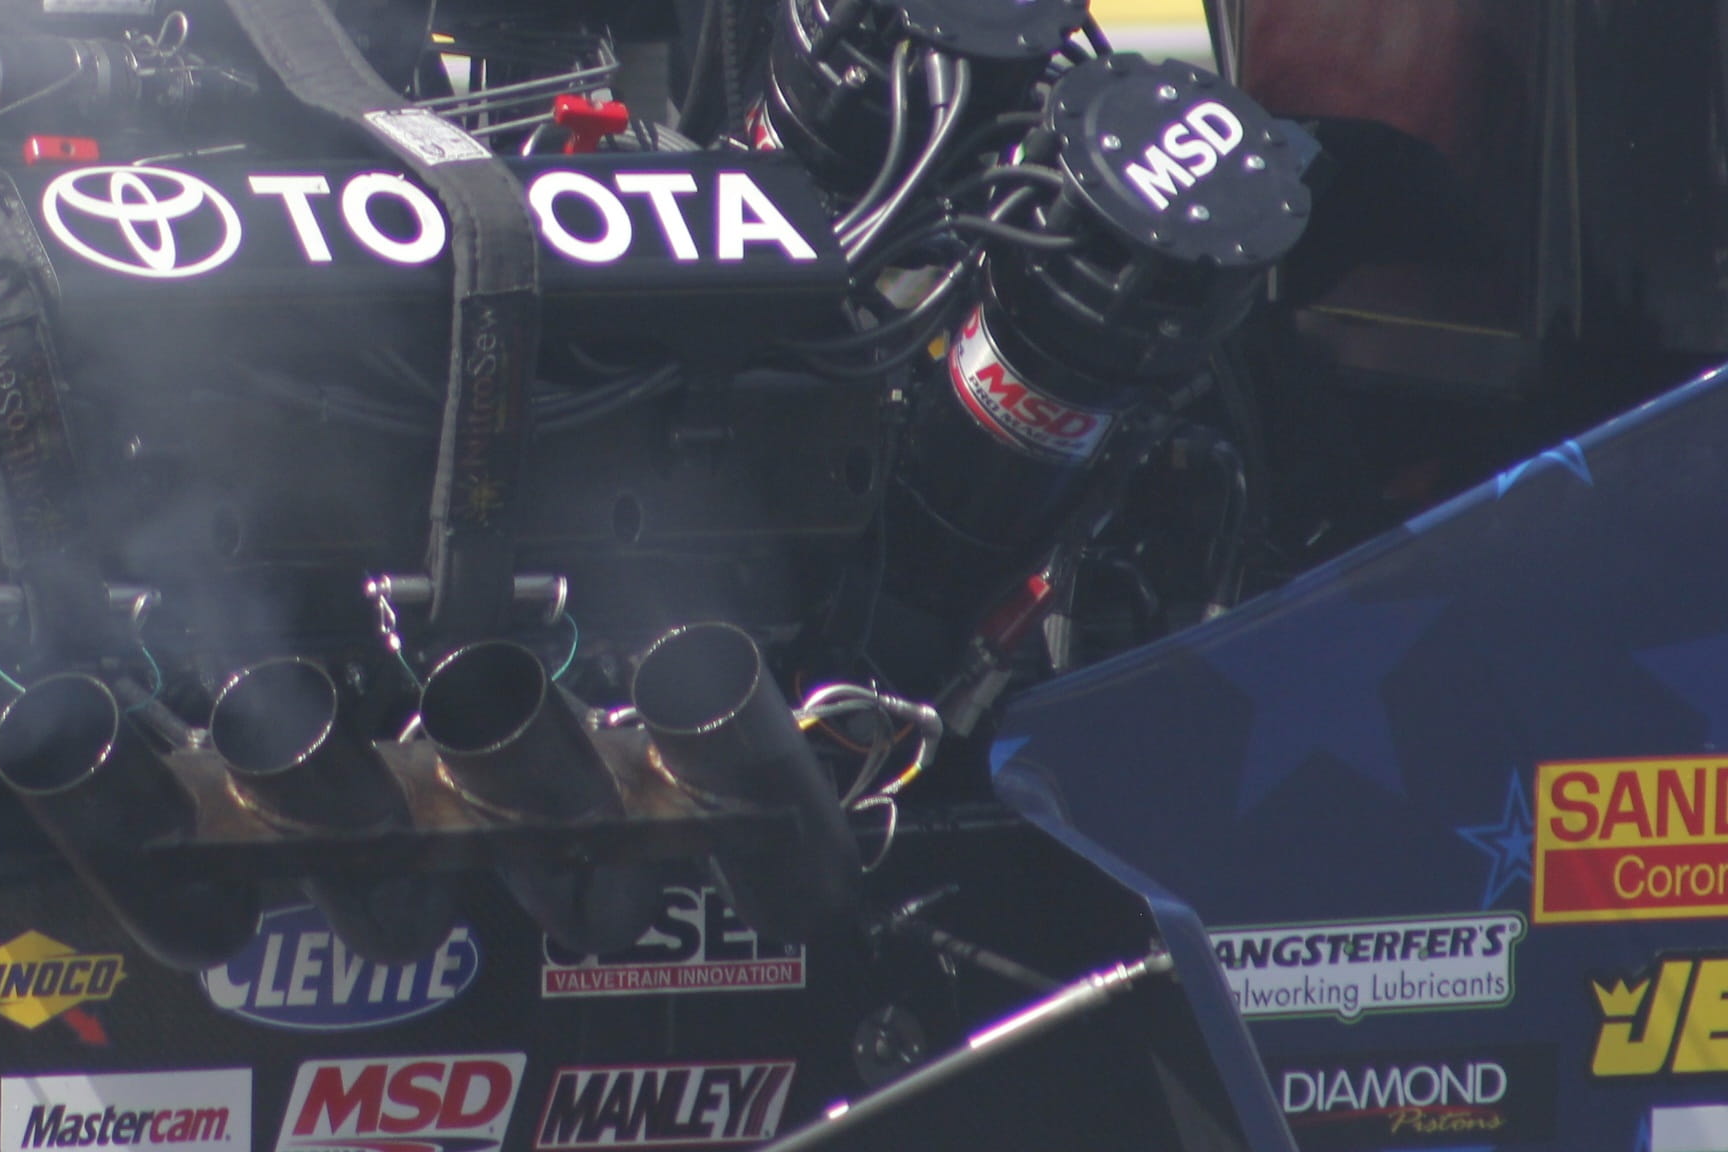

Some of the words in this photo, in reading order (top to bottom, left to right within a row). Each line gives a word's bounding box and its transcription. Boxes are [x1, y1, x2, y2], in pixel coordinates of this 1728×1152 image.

[1125, 101, 1244, 211] MSD
[248, 170, 819, 266] TOOTA
[975, 361, 1099, 439] MSD
[1215, 923, 1508, 971] ANGSTERFER'S
[554, 969, 672, 991] VALVETRAIN
[677, 964, 793, 986] INNOVATION
[1372, 969, 1506, 1002] Lubricants
[291, 1059, 514, 1136] MSD
[539, 1066, 782, 1145] MANLEY
[1283, 1061, 1508, 1113] DIAMOND
[20, 1103, 229, 1150] Mastercam
[1388, 1107, 1504, 1134] Pistons
